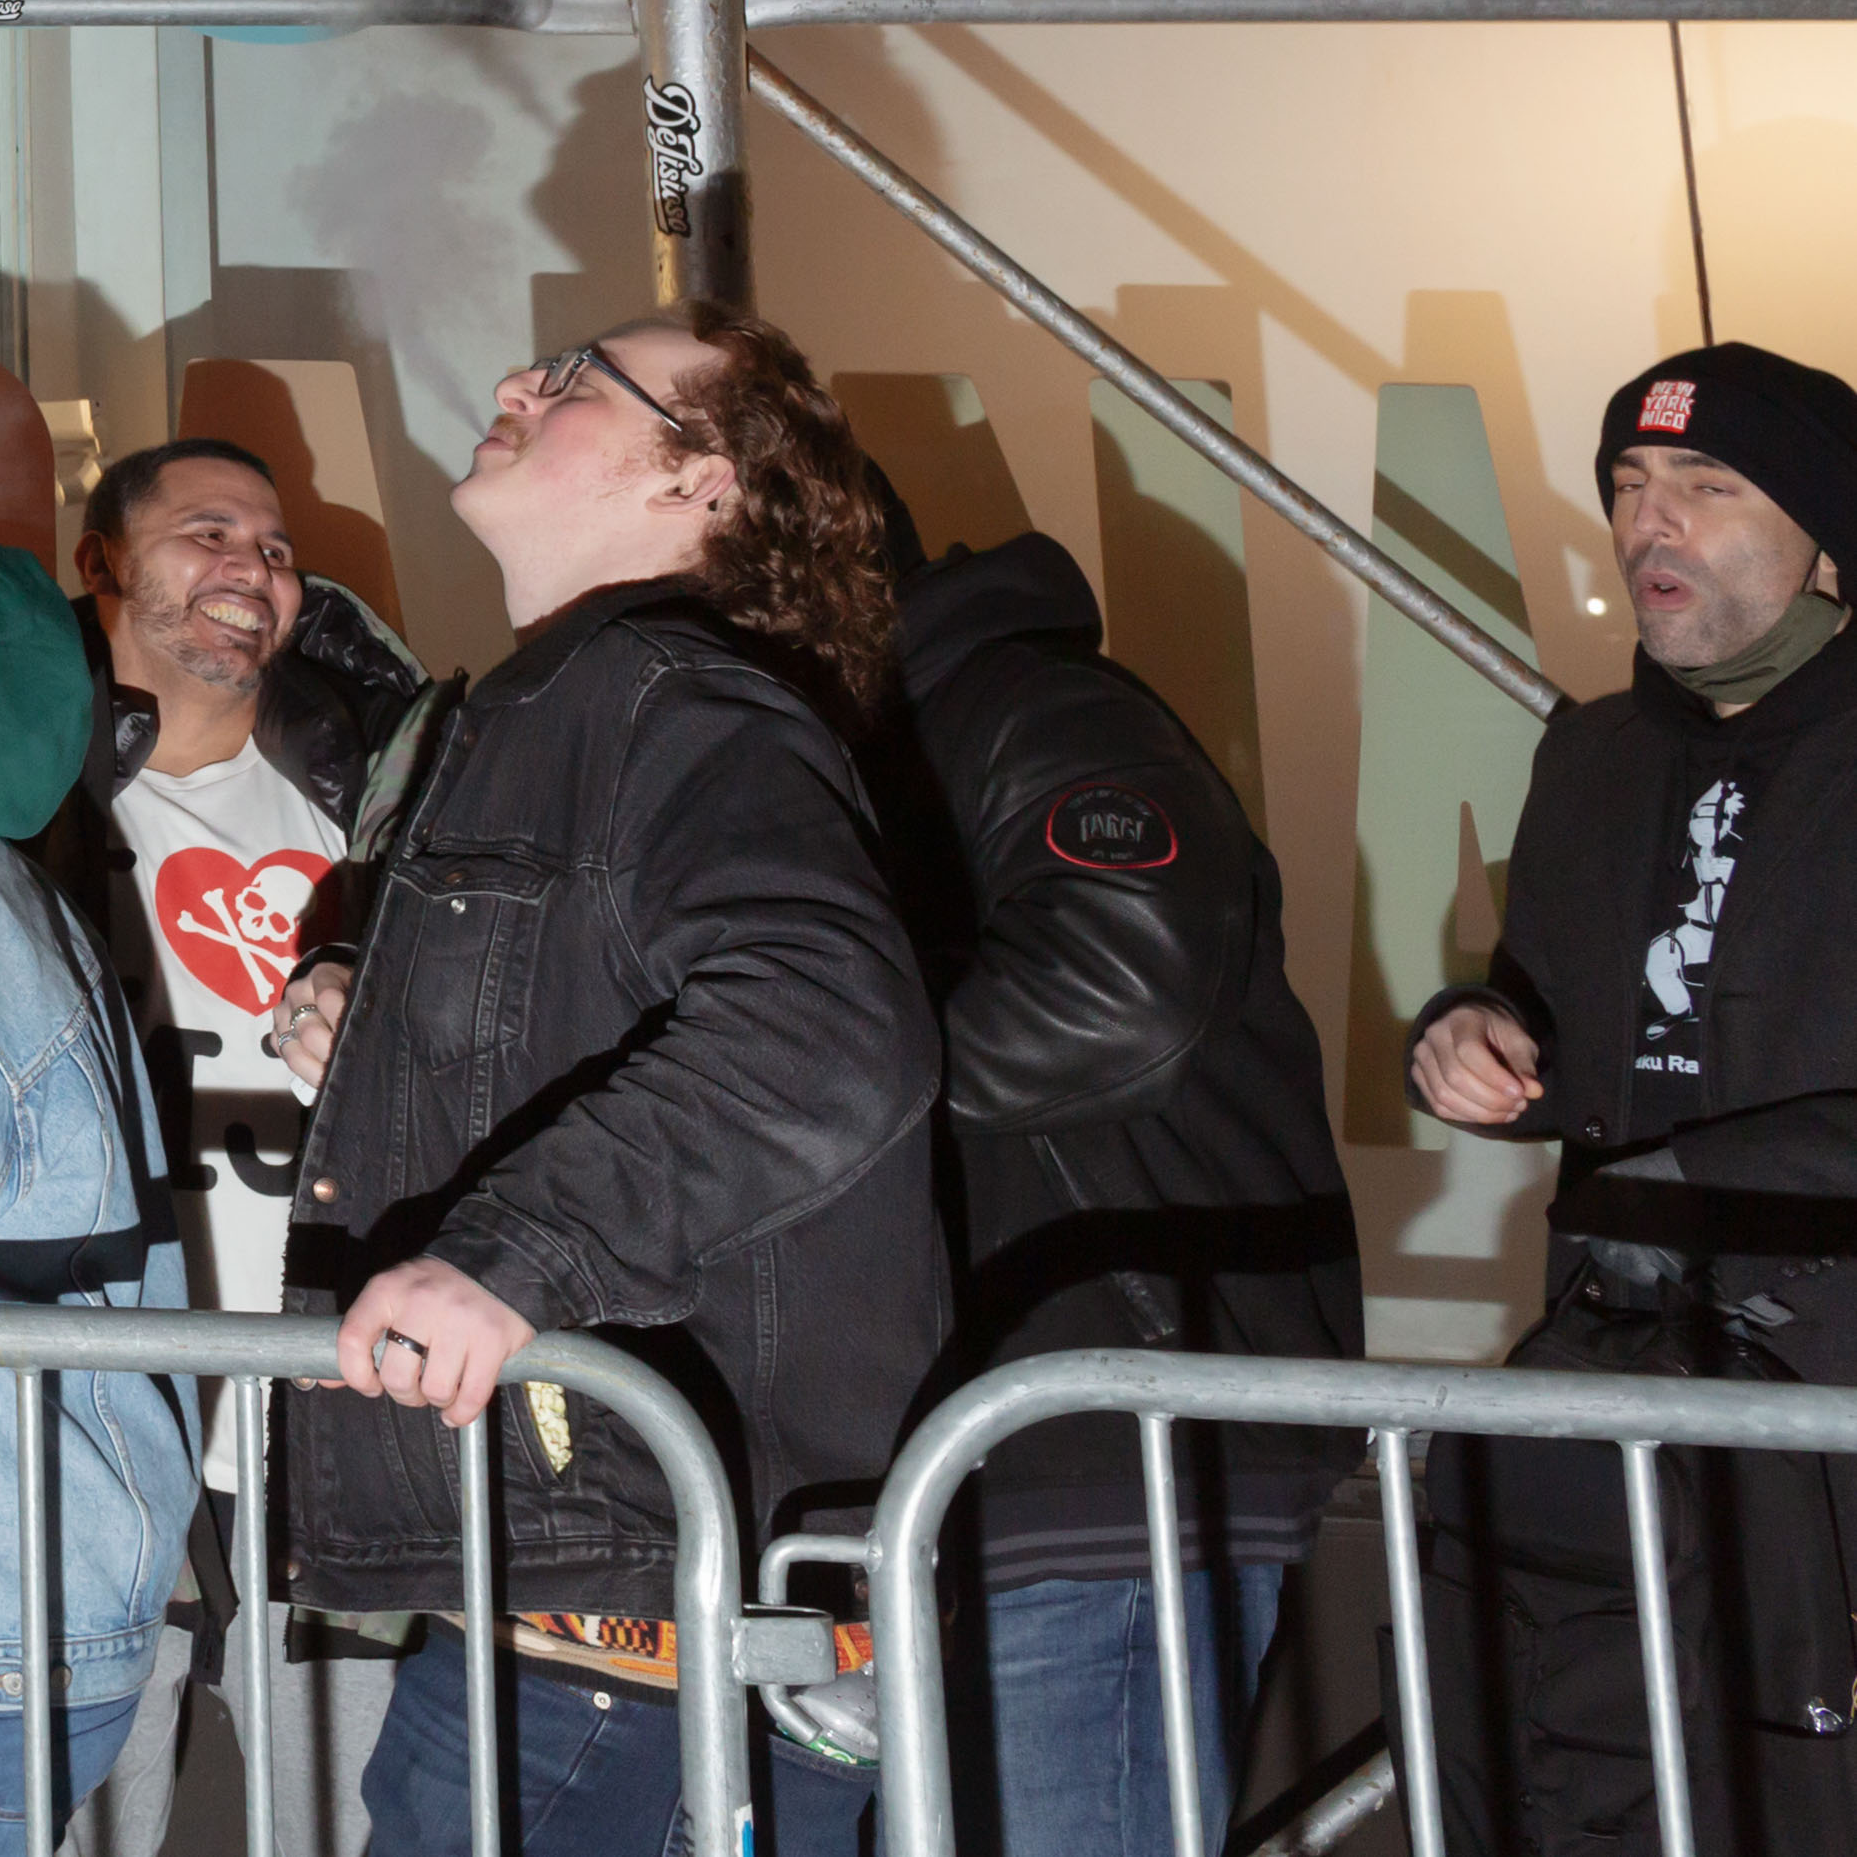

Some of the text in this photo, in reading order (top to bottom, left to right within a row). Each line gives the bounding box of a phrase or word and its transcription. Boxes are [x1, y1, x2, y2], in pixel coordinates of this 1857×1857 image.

[1650, 380, 1697, 398] NEW
[1644, 394, 1696, 416] YORK
[1638, 409, 1687, 431] NICO
[1667, 1054, 1700, 1075] Ra
